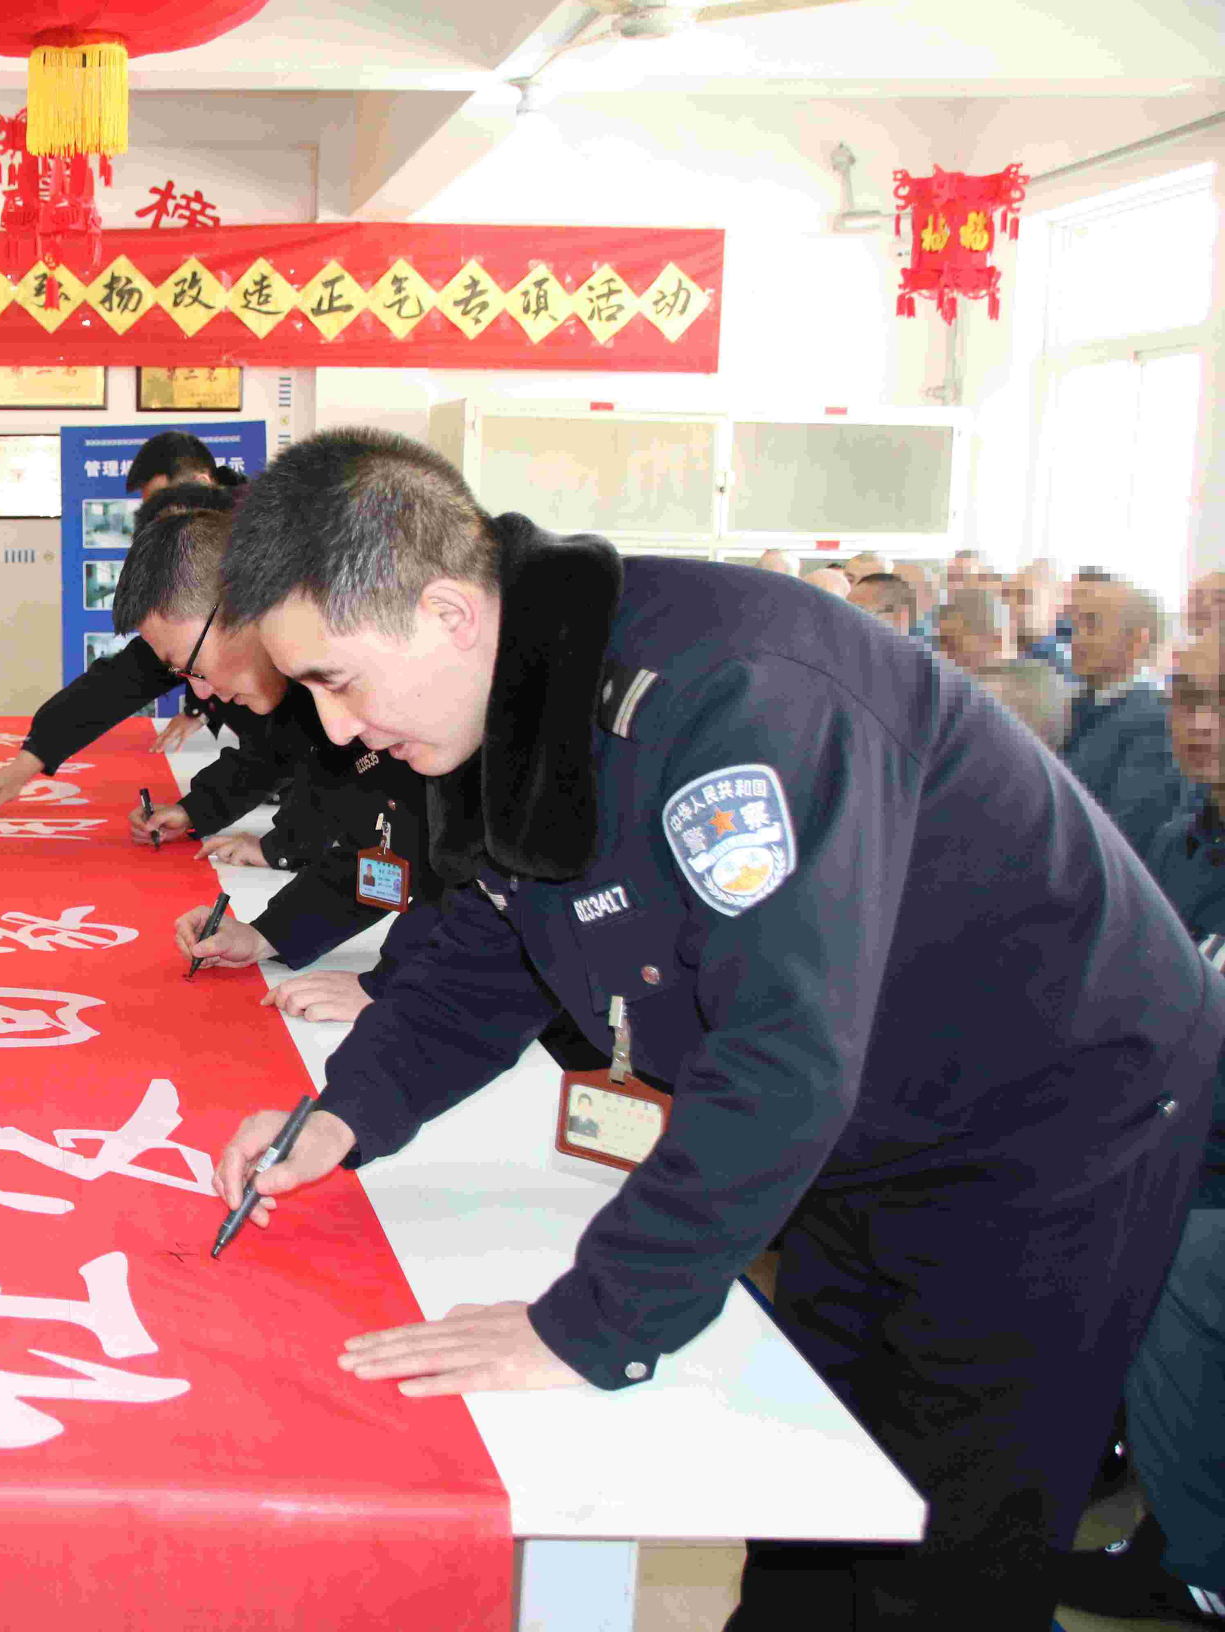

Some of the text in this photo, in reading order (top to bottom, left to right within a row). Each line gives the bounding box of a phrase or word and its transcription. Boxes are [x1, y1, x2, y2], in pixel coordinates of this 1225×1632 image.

[670, 779, 768, 833] 中华人民共和国
